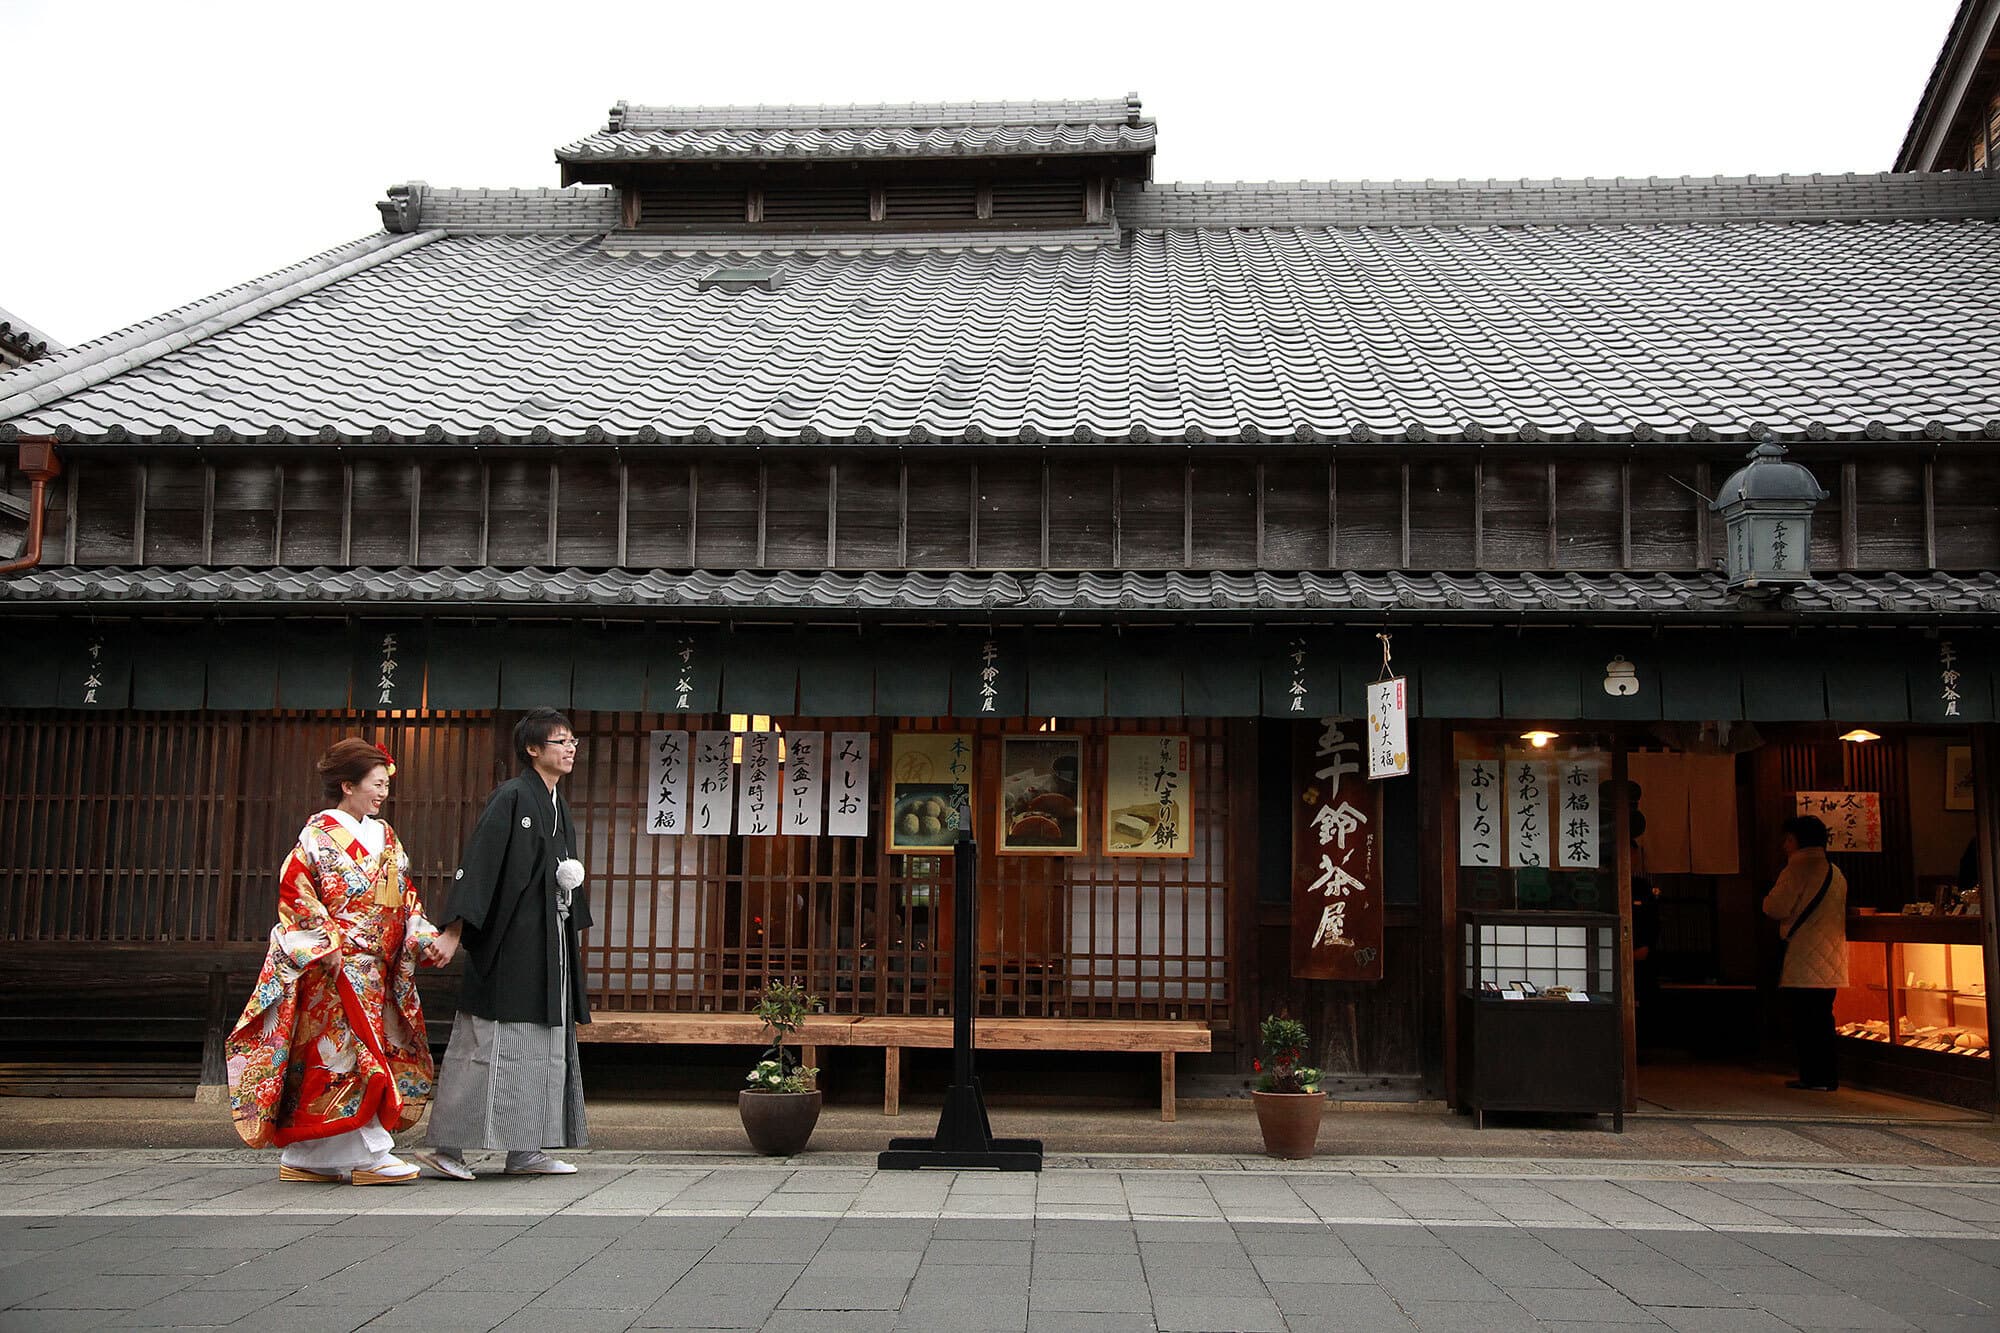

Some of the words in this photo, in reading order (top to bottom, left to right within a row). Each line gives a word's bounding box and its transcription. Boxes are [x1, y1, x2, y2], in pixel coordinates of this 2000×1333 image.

[377, 632, 398, 704] 五十鈴茶屋
[979, 640, 1000, 712] 五十鈴茶屋
[1380, 687, 1394, 767] みかん大福
[654, 734, 681, 829] みかん大福
[698, 744, 719, 829] ふわり
[748, 733, 769, 834] 宇治金時ロール
[791, 738, 812, 825] 和三盆ロール
[838, 740, 862, 814] みしお
[1471, 764, 1495, 863] おしるこ
[1517, 764, 1541, 866] あわぜんざい
[1565, 765, 1591, 862] 赤福抹茶
[1307, 713, 1368, 949] 五十鈴茶屋
